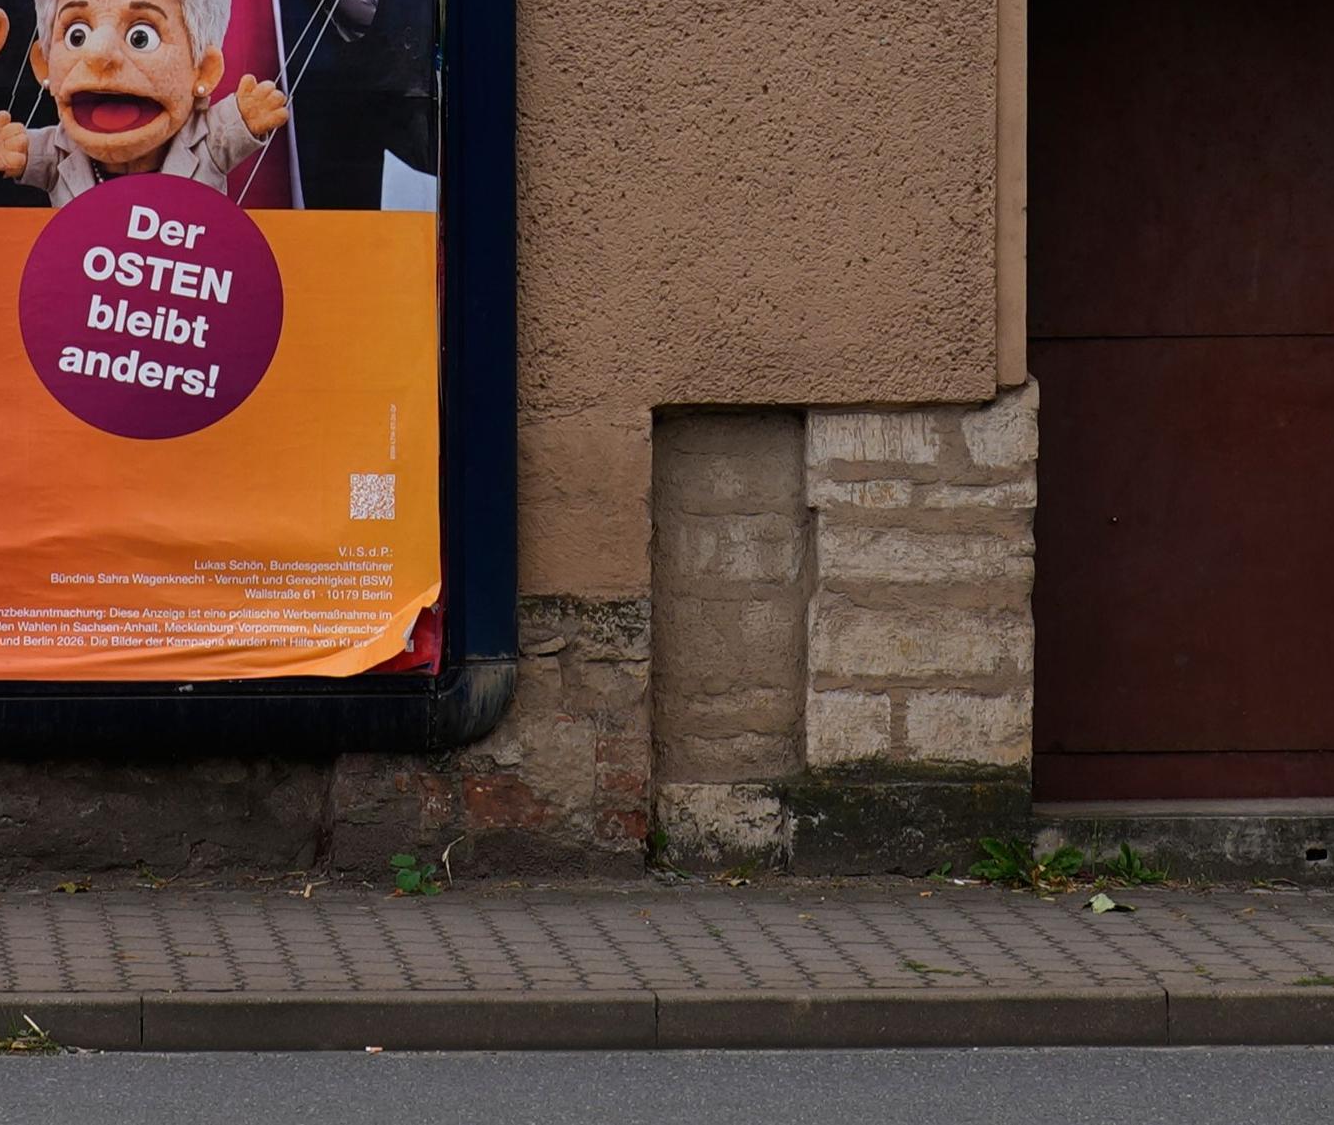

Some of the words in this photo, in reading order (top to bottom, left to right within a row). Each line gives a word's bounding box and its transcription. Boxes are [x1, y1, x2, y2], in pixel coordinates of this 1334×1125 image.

[127, 205, 205, 250] Der
[83, 246, 233, 304] OSTEN
[86, 295, 209, 348] bleibt
[58, 346, 220, 398] anders!
[194, 559, 227, 571] Lukas
[229, 559, 267, 572] Schön,
[270, 560, 394, 574] Bundesgeschäftsführer
[50, 572, 95, 584] Bündnis
[97, 573, 129, 585] Sahra
[131, 573, 205, 587] Wagenknecht
[214, 574, 259, 586] Vernunft
[262, 574, 283, 586] und
[285, 574, 357, 589] Gerechtigkeit
[359, 575, 393, 588] (BSW)
[244, 588, 301, 600] Wallstraße
[303, 588, 317, 600] 61
[326, 589, 359, 601] 10179
[361, 589, 393, 601] Berlin
[109, 607, 140, 619] Diese
[141, 607, 186, 621] Anzeige
[188, 608, 201, 620] ist
[203, 609, 227, 620] eine
[228, 608, 281, 622] politische
[282, 608, 377, 621] Werbemaßnahme
[379, 609, 393, 621] im
[17, 621, 58, 633] Wahlen
[59, 621, 70, 633] in
[72, 621, 161, 634] Sachsen-Anhalt,
[164, 622, 310, 636] Mecklenburg-Vorpommern,
[0, 635, 20, 647] und
[22, 635, 54, 647] Berlin
[56, 635, 86, 647] 2026.
[89, 635, 109, 647] Die
[110, 635, 143, 647] Bilder
[144, 636, 164, 648] der
[165, 636, 225, 650] Kampagne
[226, 637, 267, 649] wurden
[269, 637, 286, 648] mit
[289, 636, 314, 649] Hilfe
[315, 638, 337, 649] von
